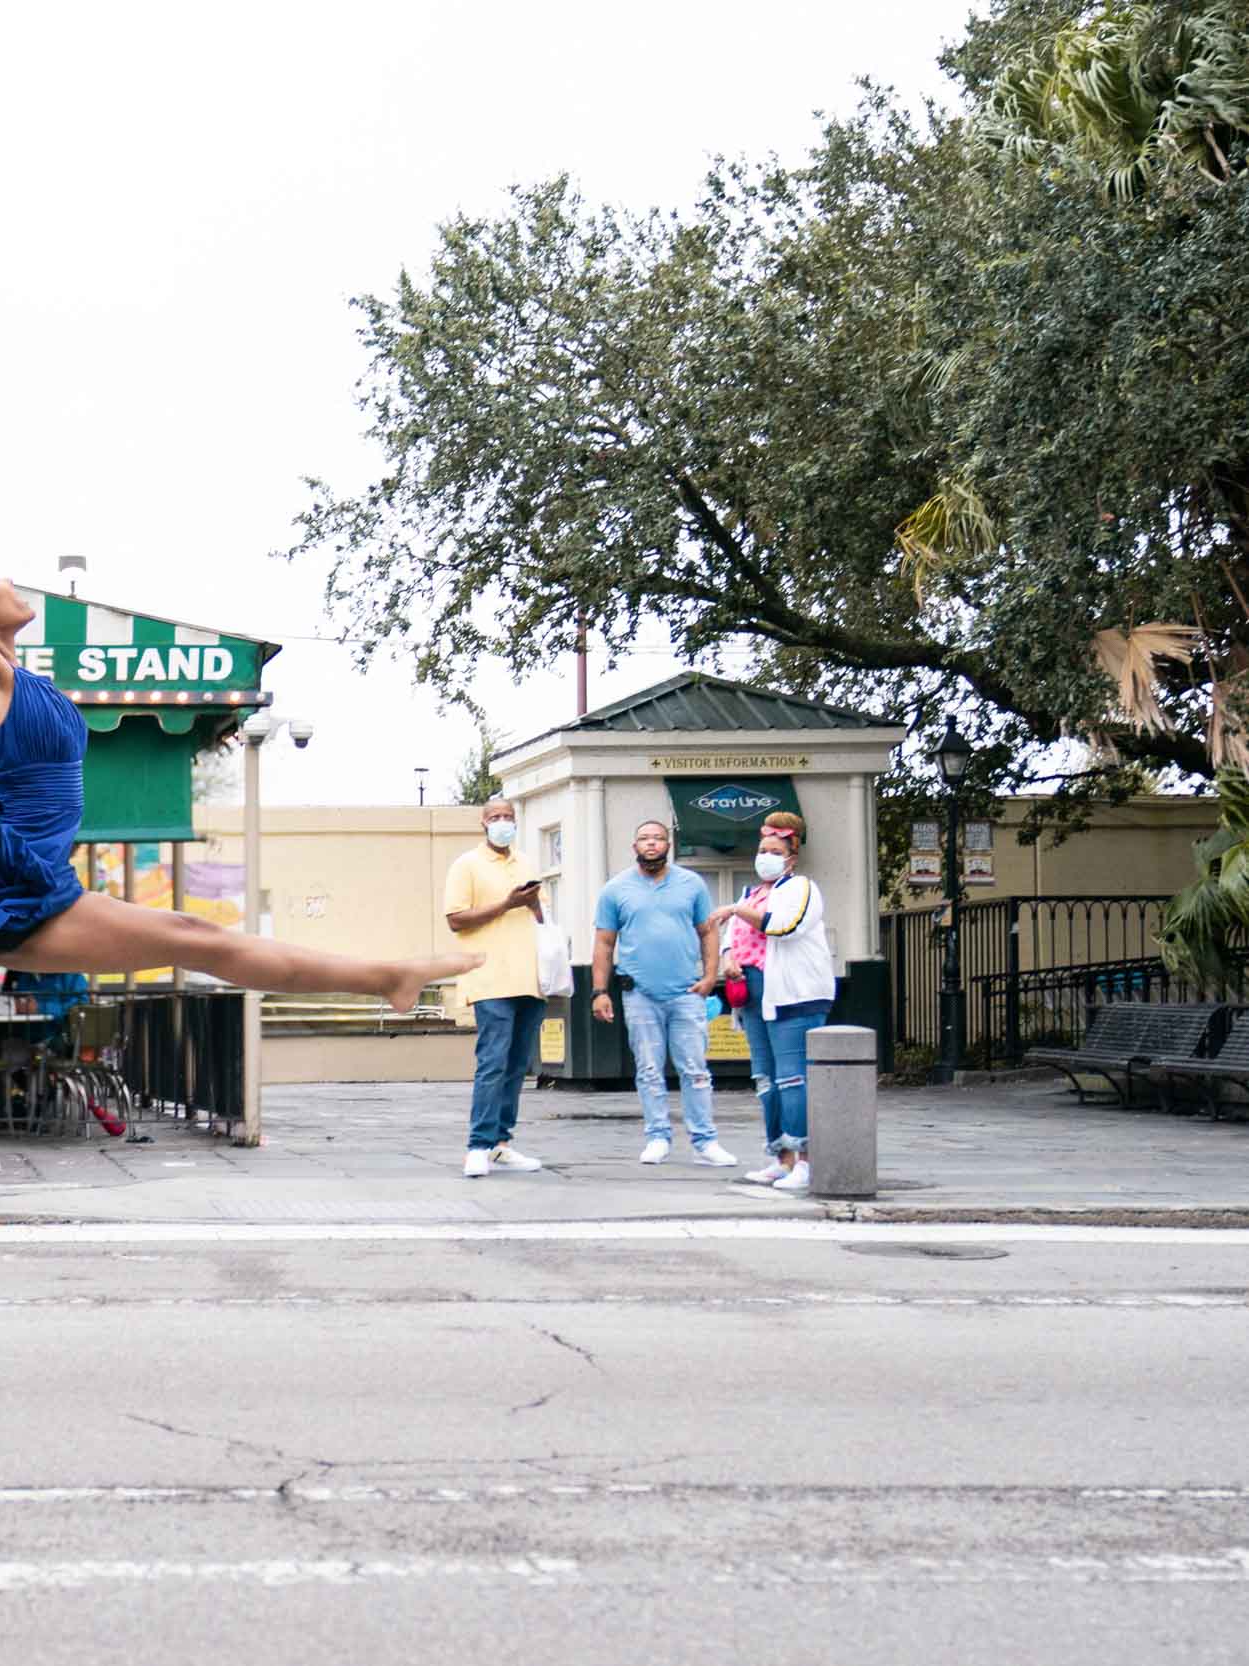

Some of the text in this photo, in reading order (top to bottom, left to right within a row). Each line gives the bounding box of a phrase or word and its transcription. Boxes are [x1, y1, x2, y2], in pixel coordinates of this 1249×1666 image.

[77, 647, 233, 681] STAND
[664, 756, 796, 769] VISITOR INFORMATION
[698, 798, 737, 809] Gray
